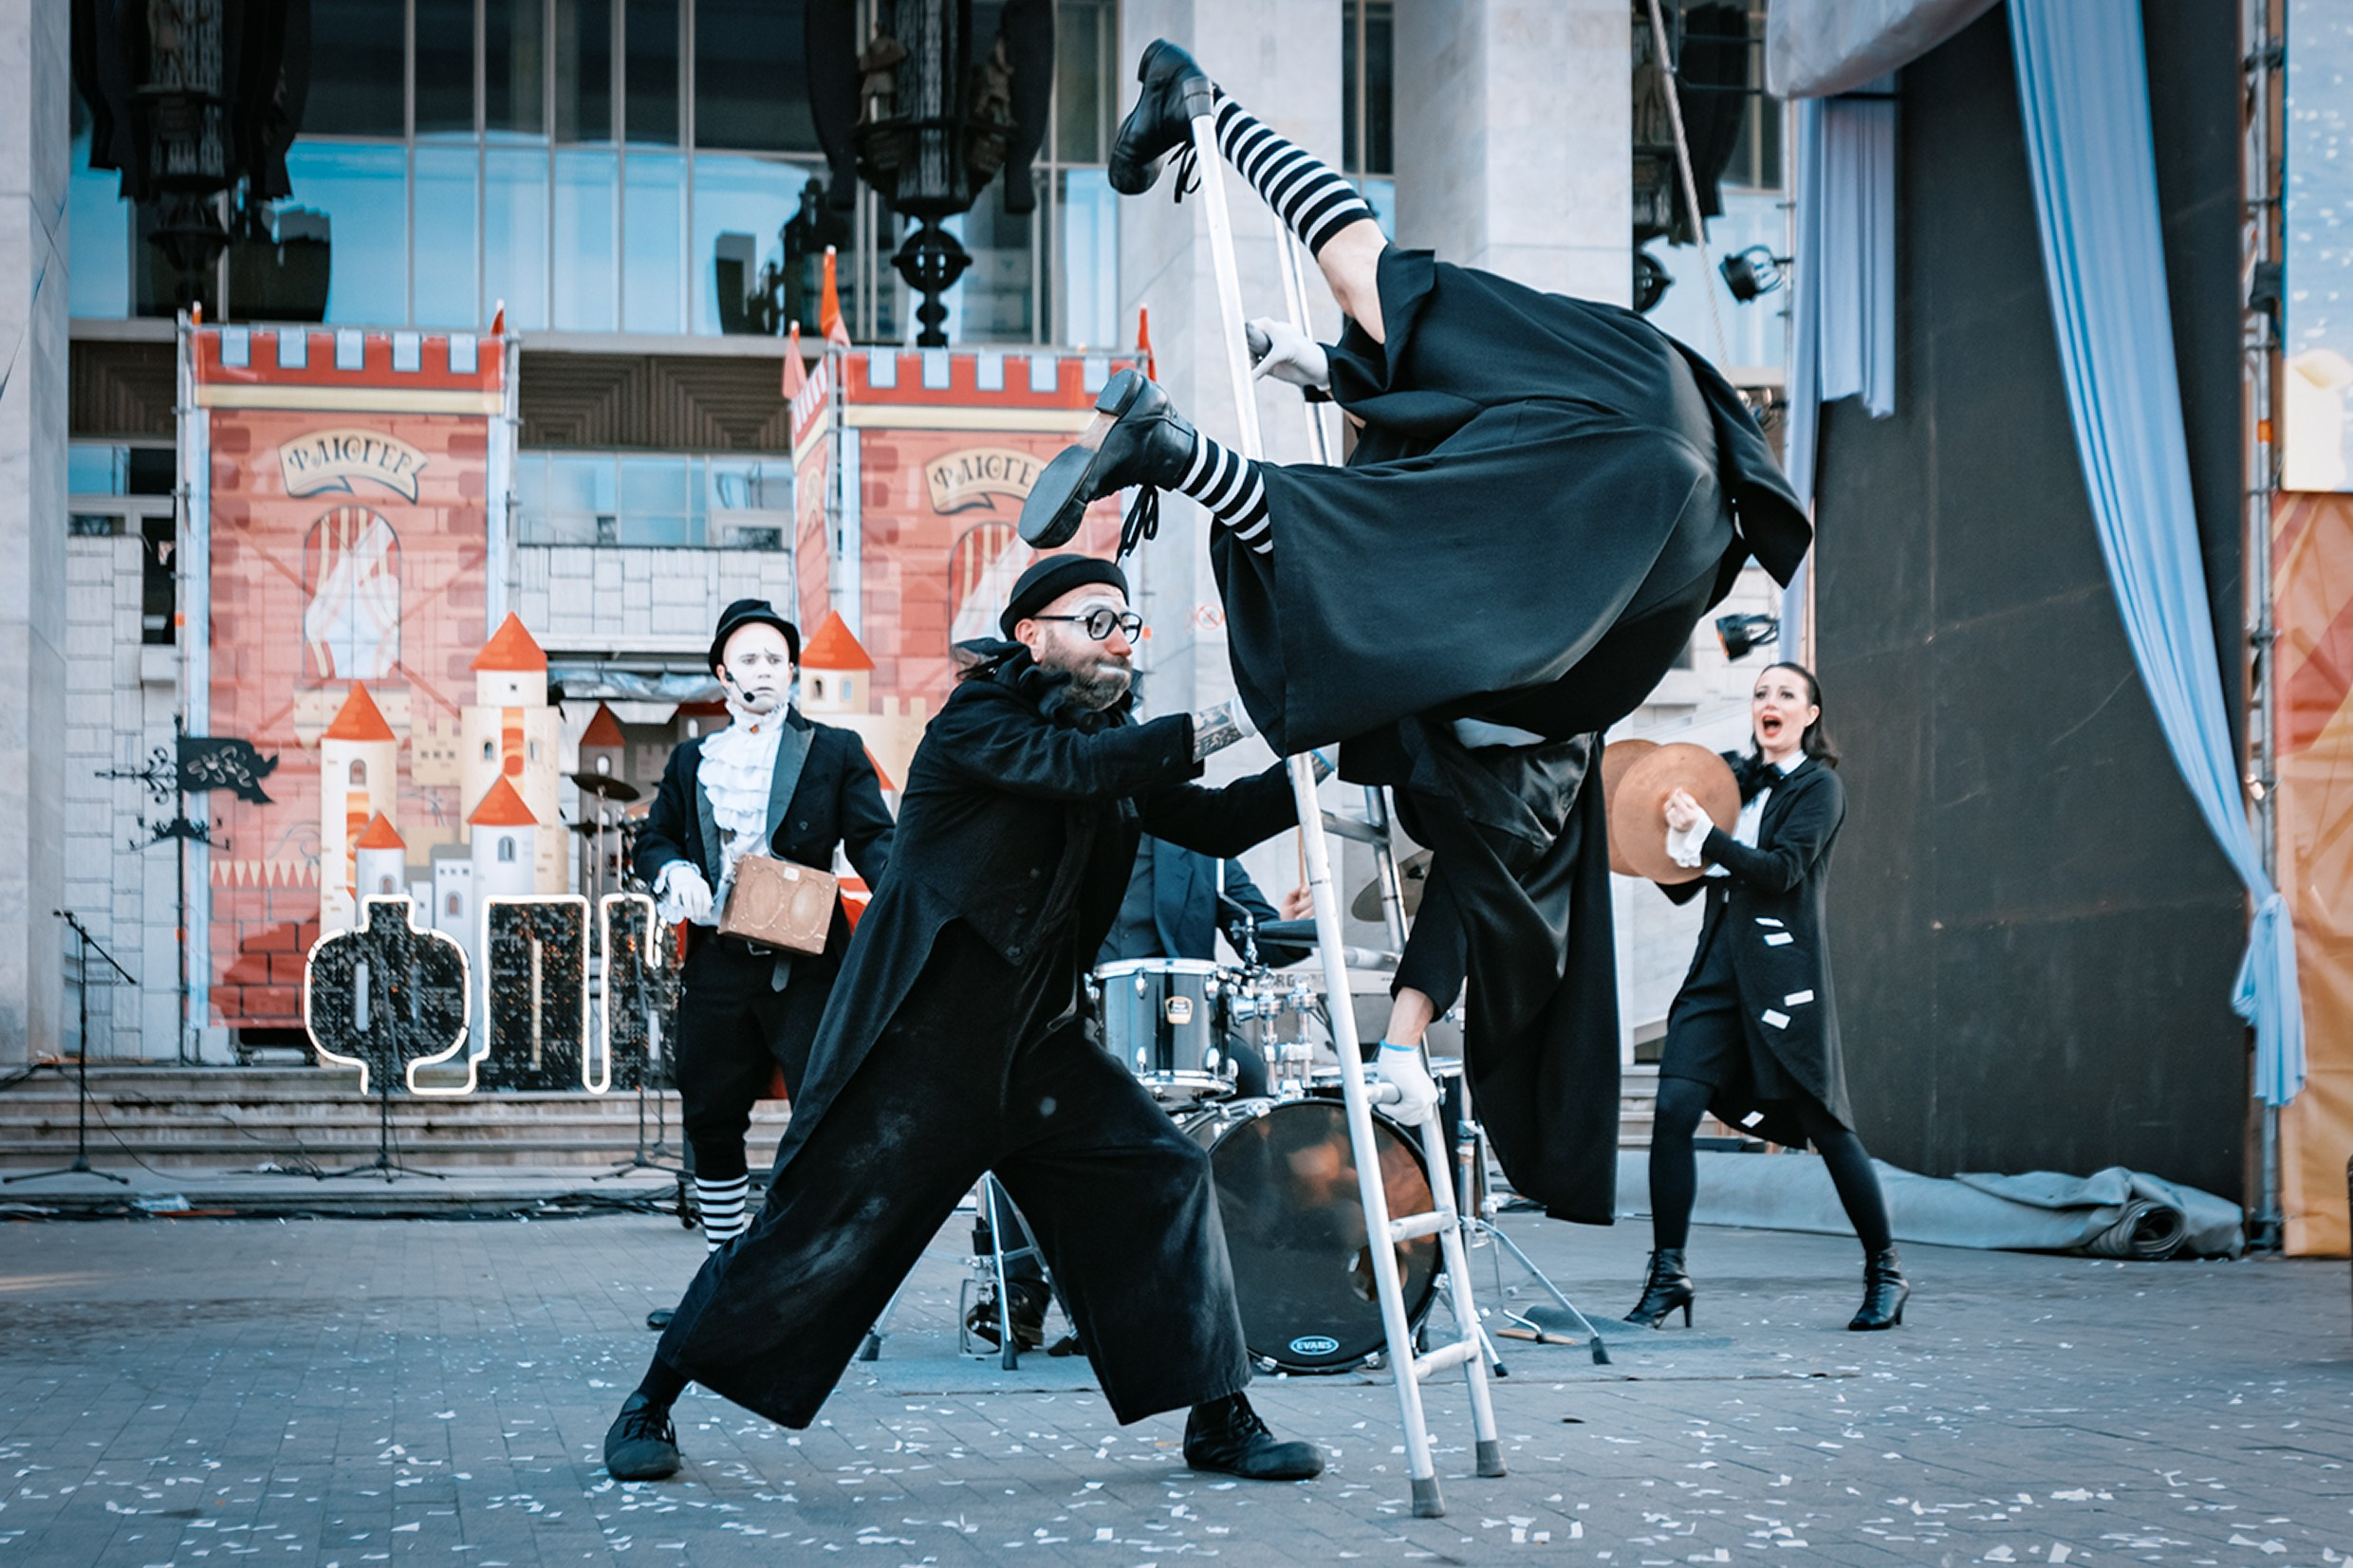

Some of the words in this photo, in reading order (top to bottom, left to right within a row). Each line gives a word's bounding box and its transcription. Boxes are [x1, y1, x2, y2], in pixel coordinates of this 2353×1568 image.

[288, 435, 412, 472] ФЛЮГЕР
[934, 455, 1037, 489] ФЛЮГЕ
[1296, 1340, 1332, 1350] EVANS
